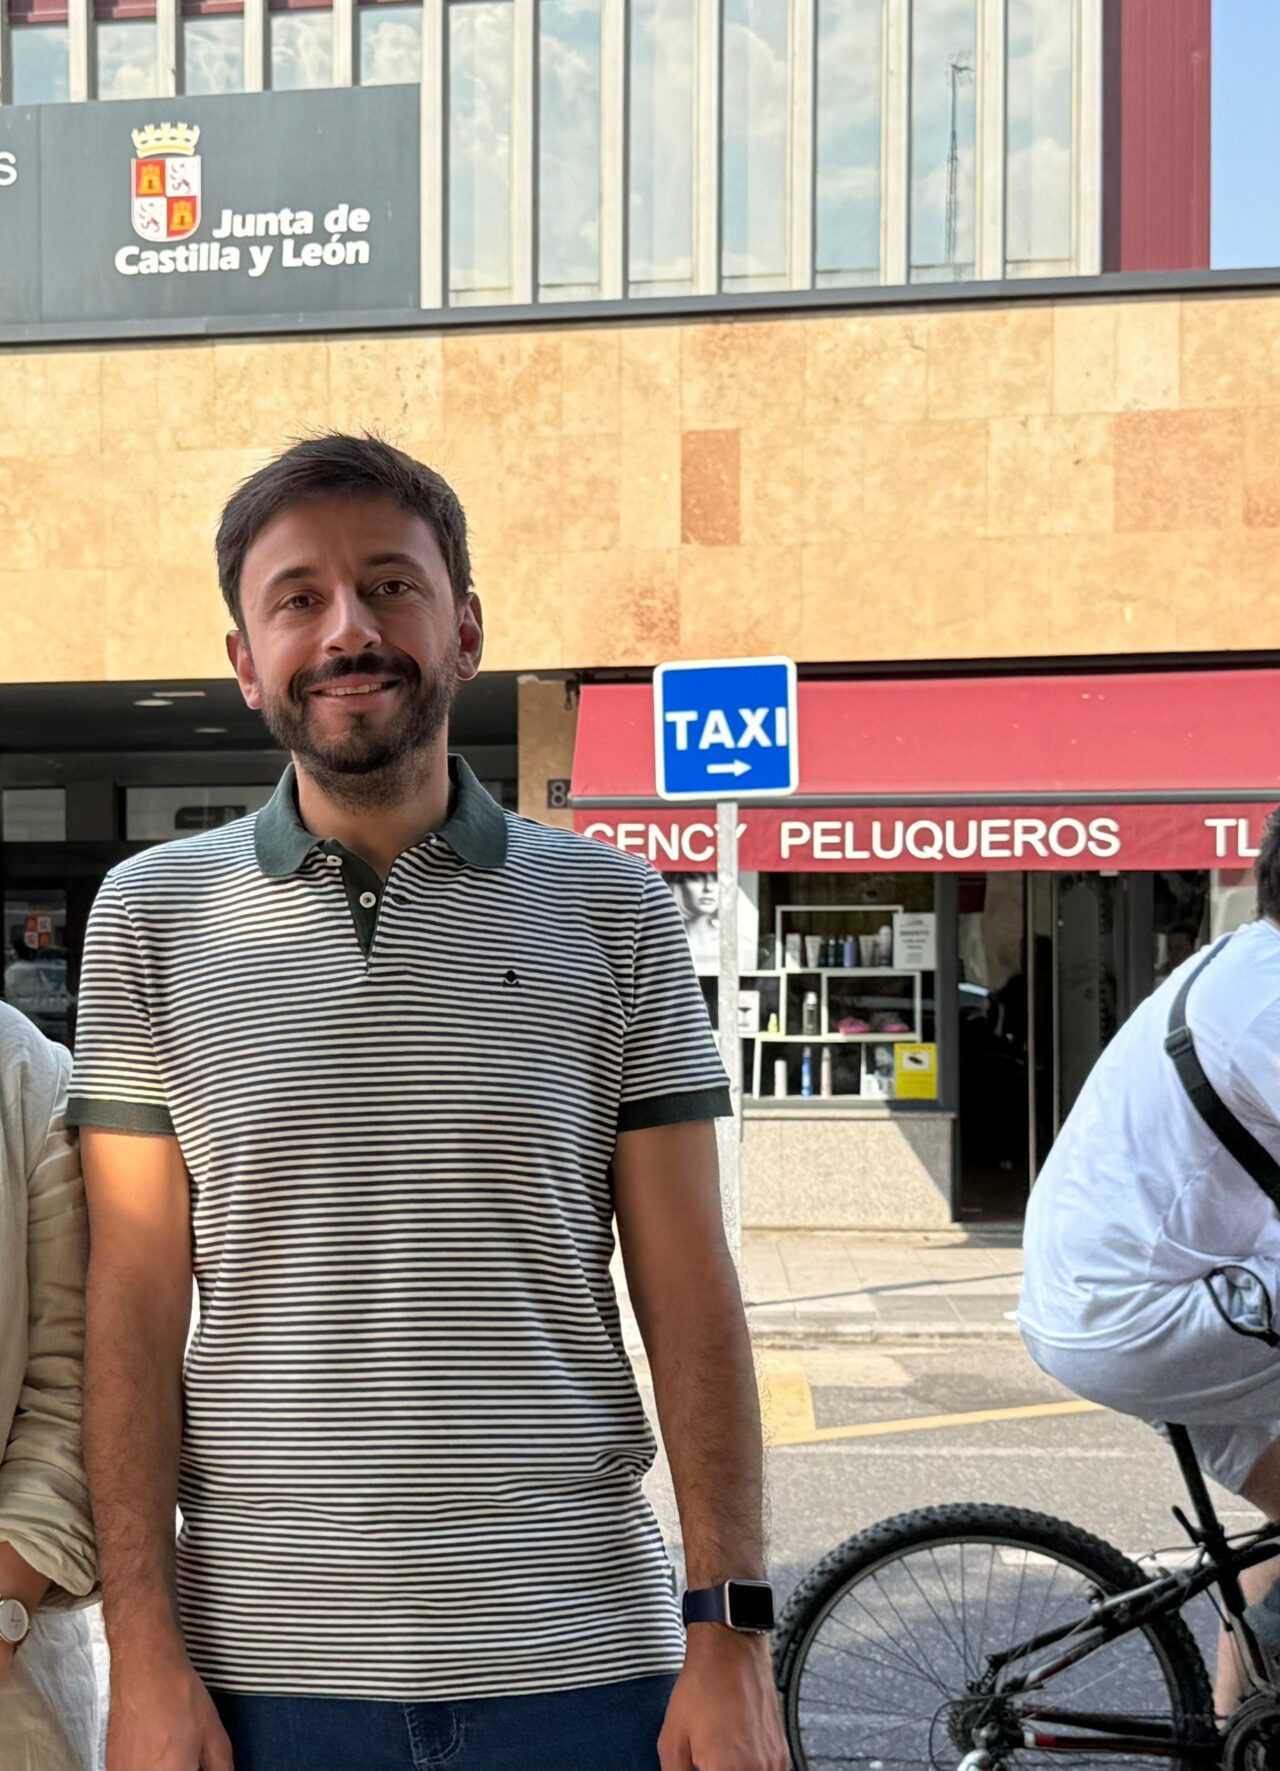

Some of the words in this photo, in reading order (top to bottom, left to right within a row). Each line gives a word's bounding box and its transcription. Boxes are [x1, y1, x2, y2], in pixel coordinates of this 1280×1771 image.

[212, 207, 315, 239] Junta
[324, 203, 371, 234] de
[114, 242, 241, 276] Castilla
[247, 246, 274, 278] y
[282, 234, 371, 269] León
[665, 706, 789, 751] TAXI
[780, 818, 1121, 860] PELUQUEROS
